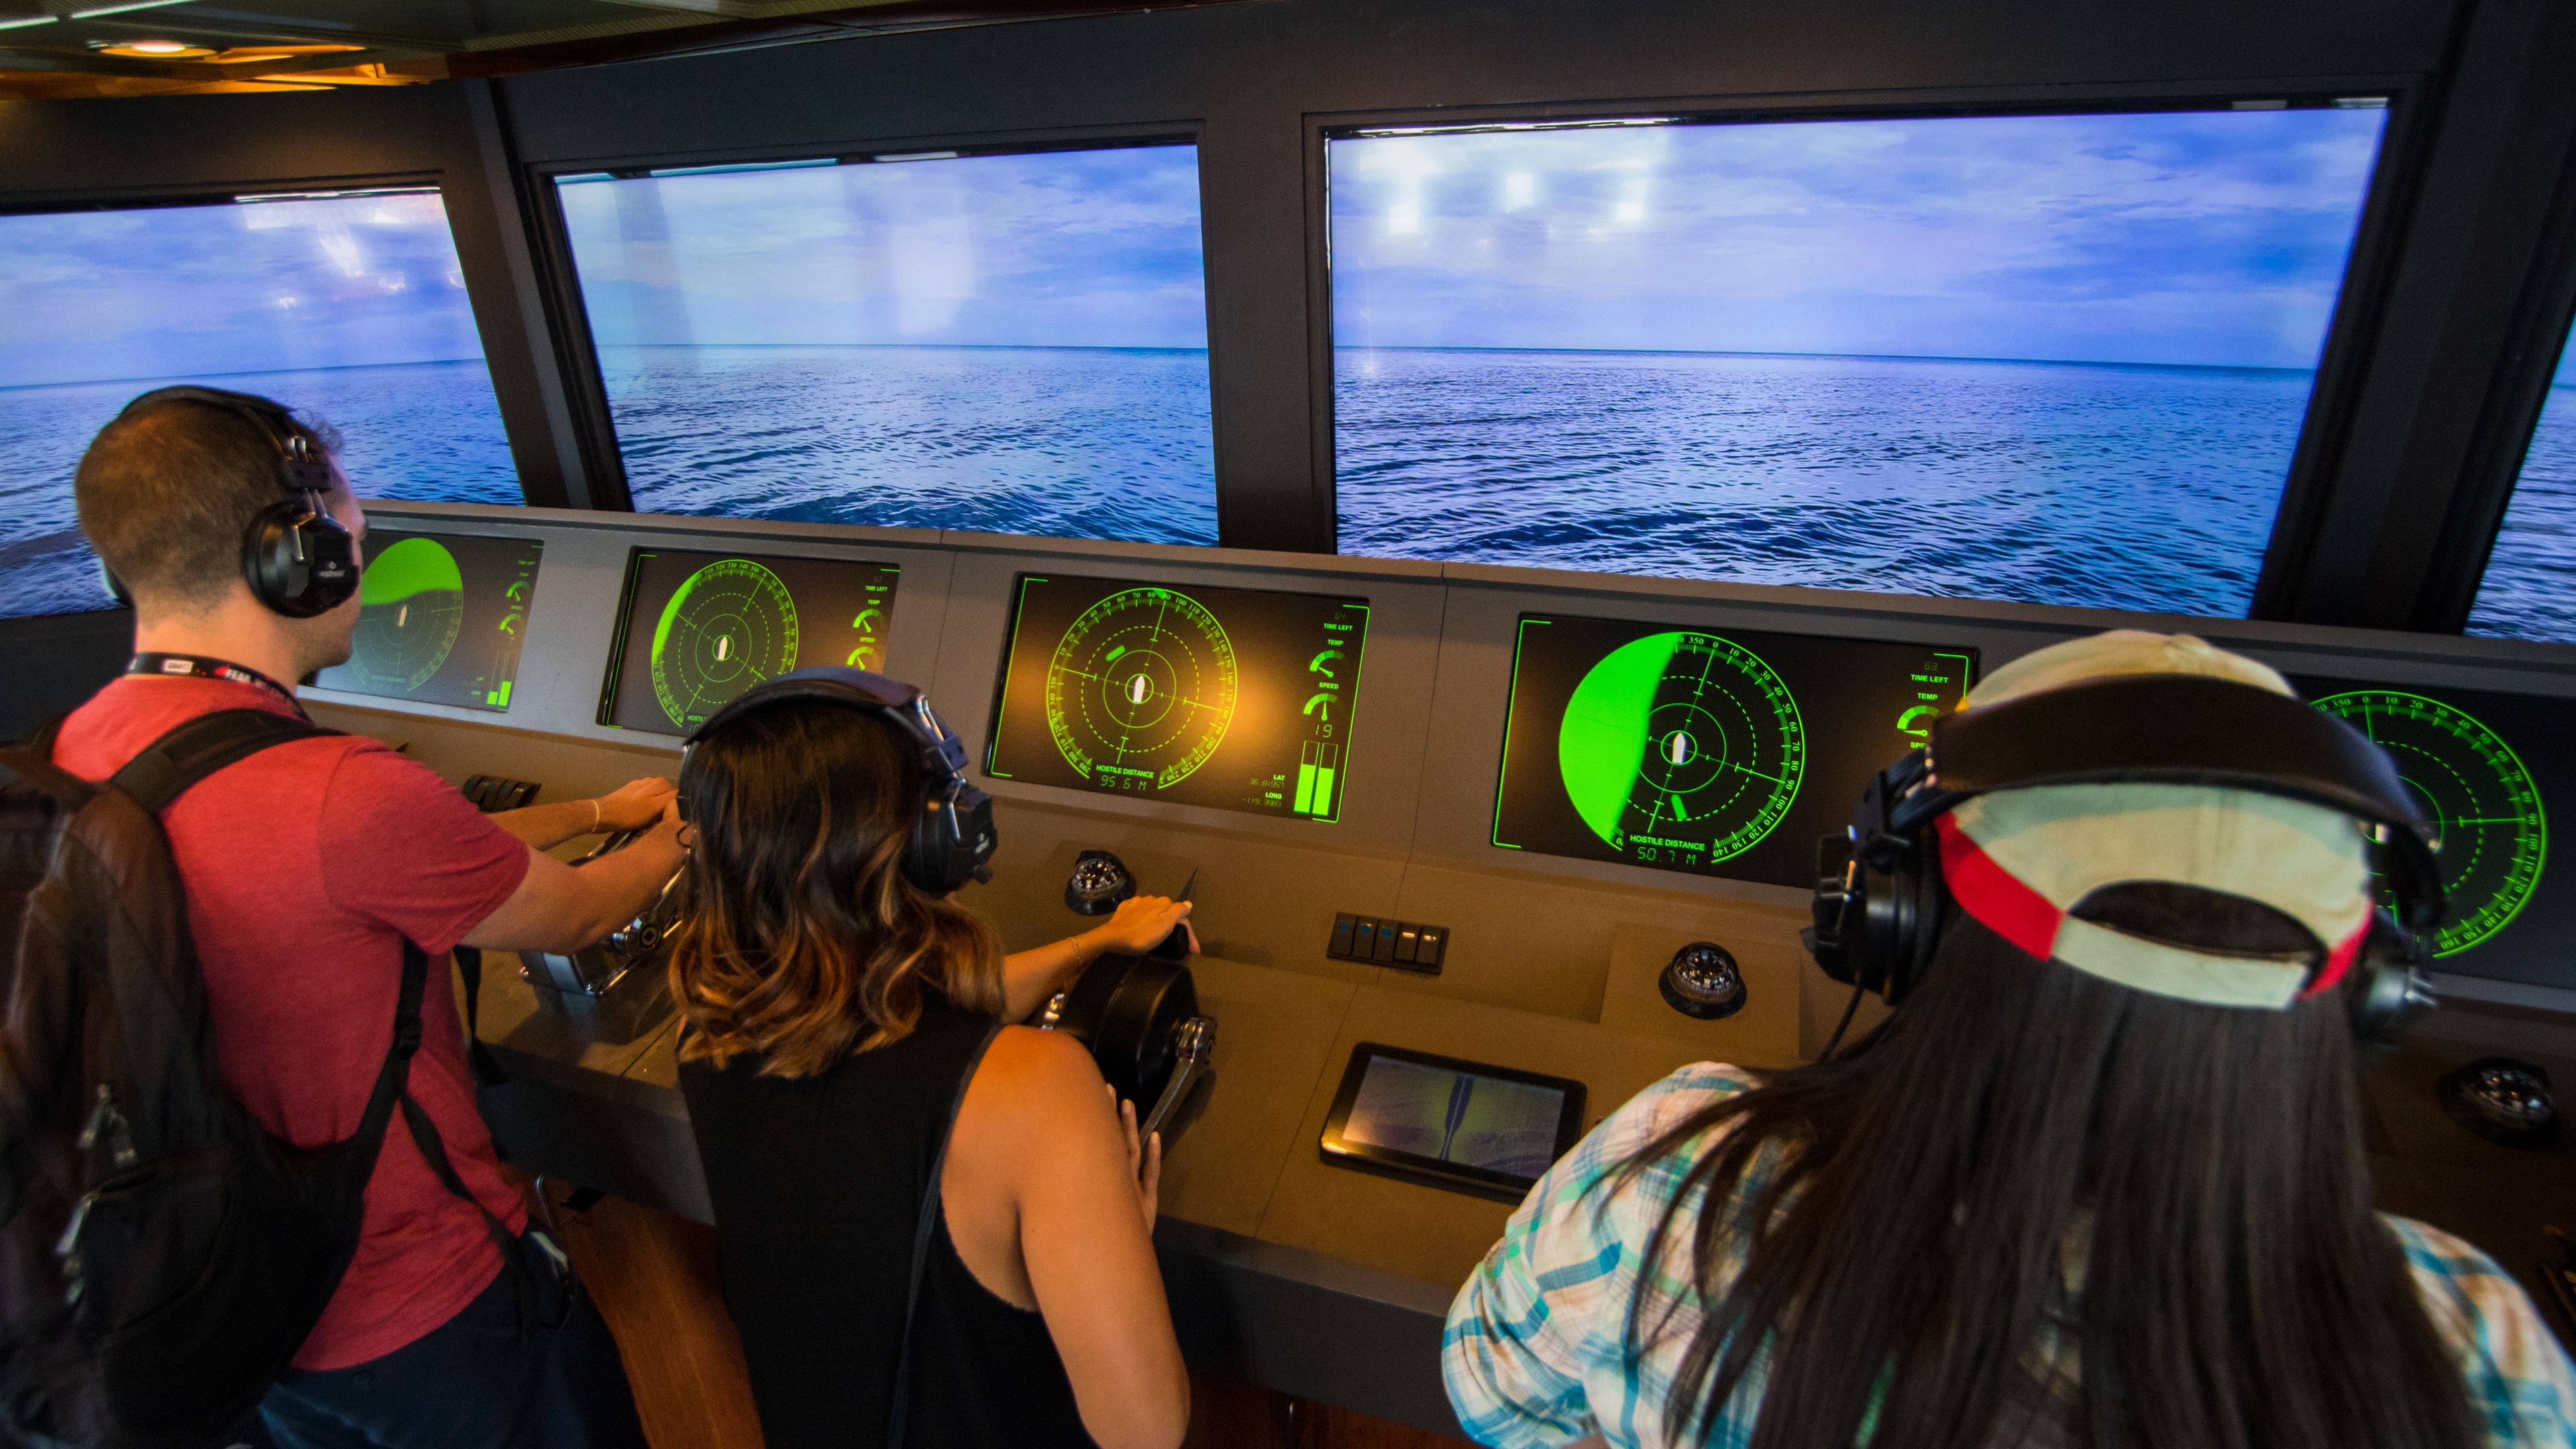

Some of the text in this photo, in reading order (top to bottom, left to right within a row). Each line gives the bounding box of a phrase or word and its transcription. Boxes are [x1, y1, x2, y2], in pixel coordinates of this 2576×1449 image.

[1103, 601, 1111, 609] 50
[1175, 597, 1187, 606] 100
[1189, 604, 1200, 614] 110
[1201, 614, 1212, 625] 120
[1067, 633, 1075, 641] 20
[1211, 625, 1221, 637] 130
[1059, 647, 1067, 656] 10
[1218, 640, 1228, 652] 140
[1224, 655, 1232, 668] 150
[1924, 661, 1937, 671] 63
[1911, 674, 1928, 682] TIME
[1319, 682, 1339, 690] SPEED
[1917, 692, 1938, 700] TEMP
[2362, 695, 2369, 704] 0
[2385, 696, 2398, 704] 10
[2332, 698, 2351, 708] 350
[2409, 699, 2423, 709] 20
[1222, 706, 1230, 718] 180
[2434, 707, 2448, 718] 30
[1055, 724, 1063, 737] 320
[1216, 722, 1225, 735] 190
[1316, 724, 1332, 738] 19
[1060, 738, 1071, 751] 310
[1206, 737, 1217, 750] 200
[1688, 637, 1800, 857] 350 0 10 20 30 40 50 60 70 80 90 100 110 120 130 140
[1069, 751, 1080, 763] 300
[1194, 749, 1206, 763] 210
[1079, 762, 1091, 773] 290
[1096, 765, 1155, 779] HOSTILE DISTANCE
[1181, 761, 1194, 773] 220
[1101, 775, 1131, 790] 95.6
[1138, 781, 1147, 790] M
[1167, 771, 1179, 782] 230
[1265, 792, 1283, 800] LONG
[1629, 834, 1664, 845] HOSTILE
[1665, 839, 1705, 851] DISTANCE
[2528, 833, 2538, 851] 100
[1685, 853, 1697, 865] M
[2524, 855, 2537, 872] 110
[2440, 936, 2461, 949] 160
